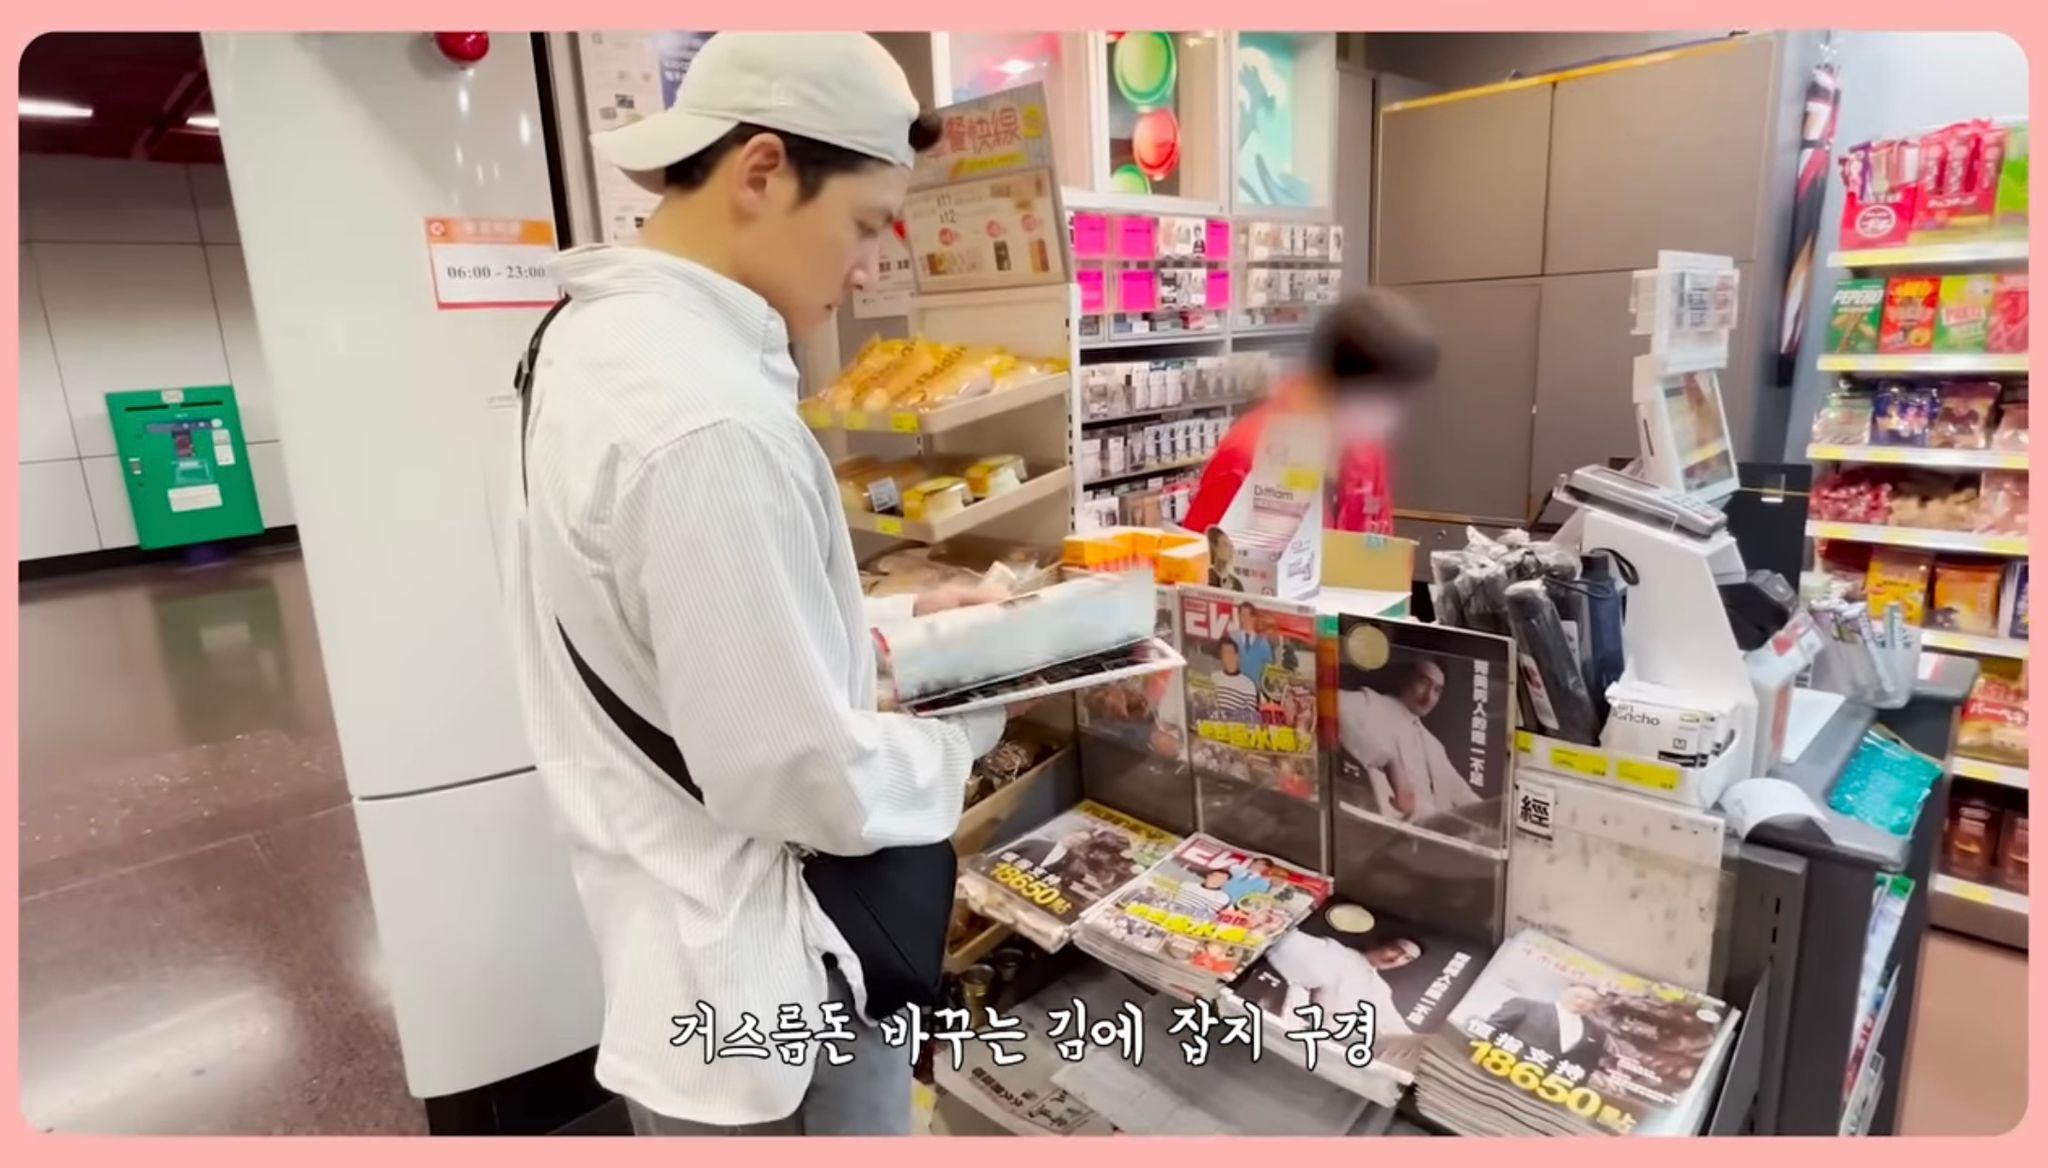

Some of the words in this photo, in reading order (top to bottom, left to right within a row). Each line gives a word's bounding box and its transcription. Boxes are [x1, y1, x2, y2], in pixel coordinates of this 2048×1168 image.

[447, 265, 491, 279] 06:00
[506, 265, 546, 279] 23:00
[1520, 795, 1550, 829] 經
[1468, 1039, 1637, 1137] 18650點
